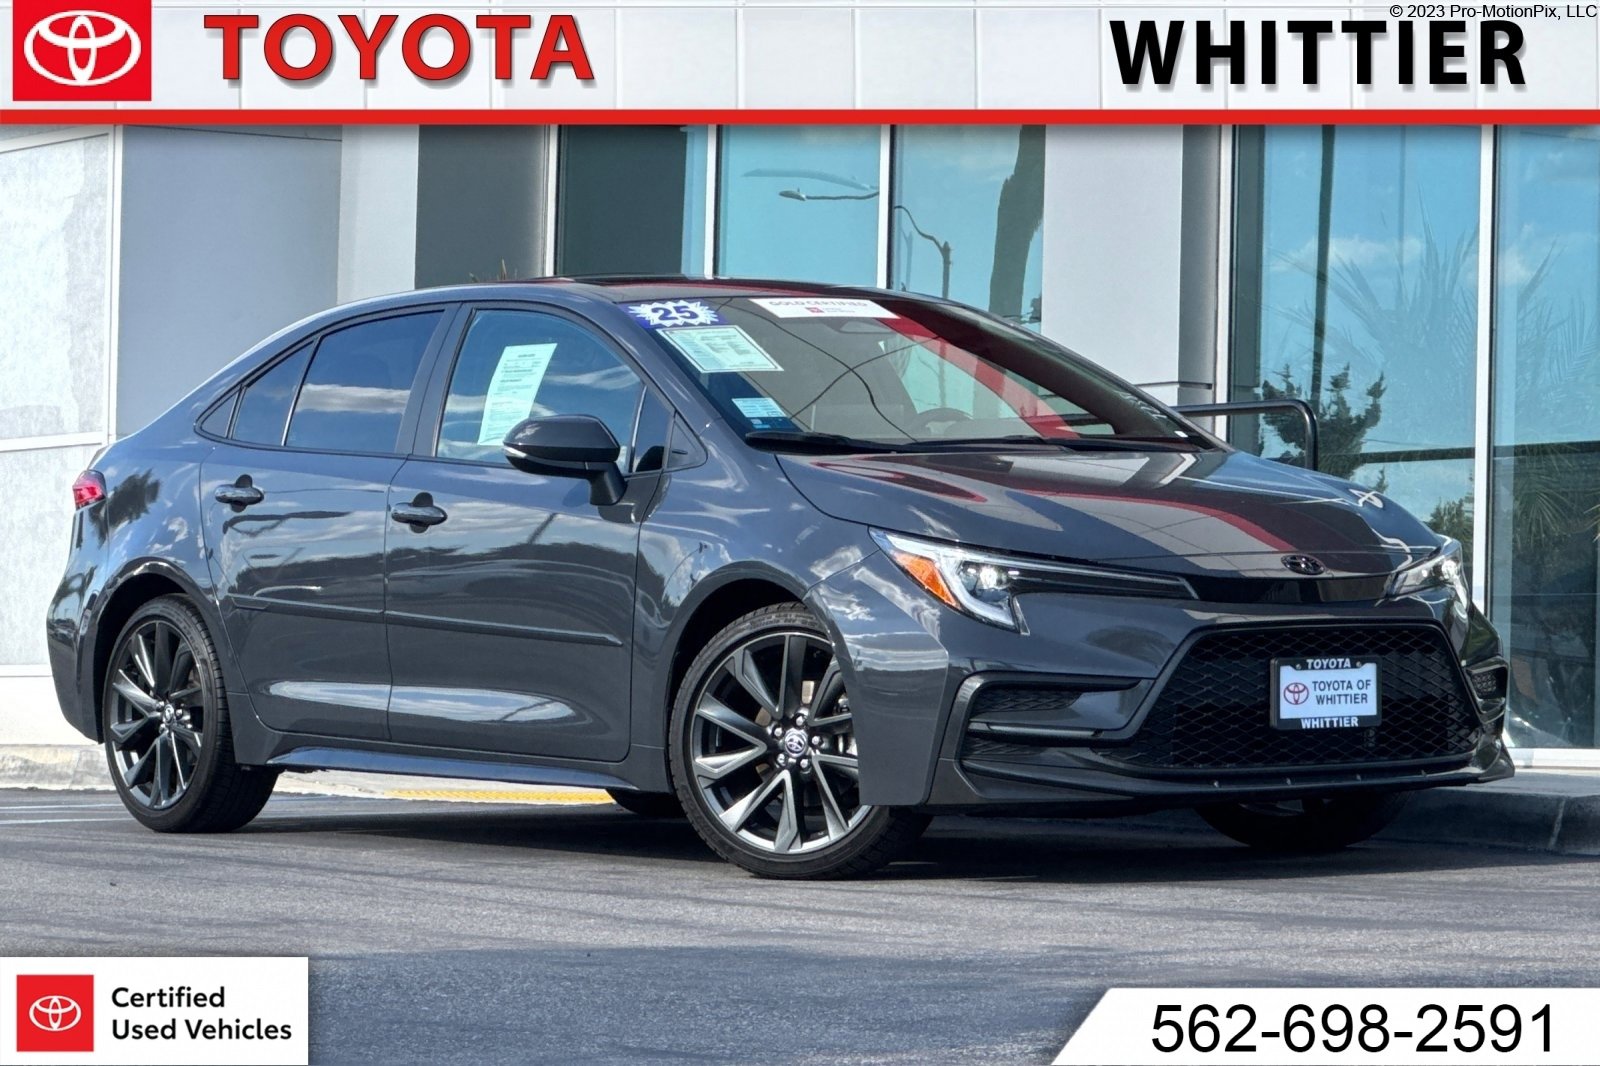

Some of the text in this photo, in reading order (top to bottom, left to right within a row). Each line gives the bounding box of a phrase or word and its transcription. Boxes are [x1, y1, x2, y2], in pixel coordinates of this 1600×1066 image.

[650, 305, 700, 321] 25
[1306, 658, 1351, 669] TOYOTA
[1312, 679, 1372, 692] TOYOTA OF
[1316, 693, 1368, 705] WHITTIER
[1301, 717, 1359, 729] WHITTIER
